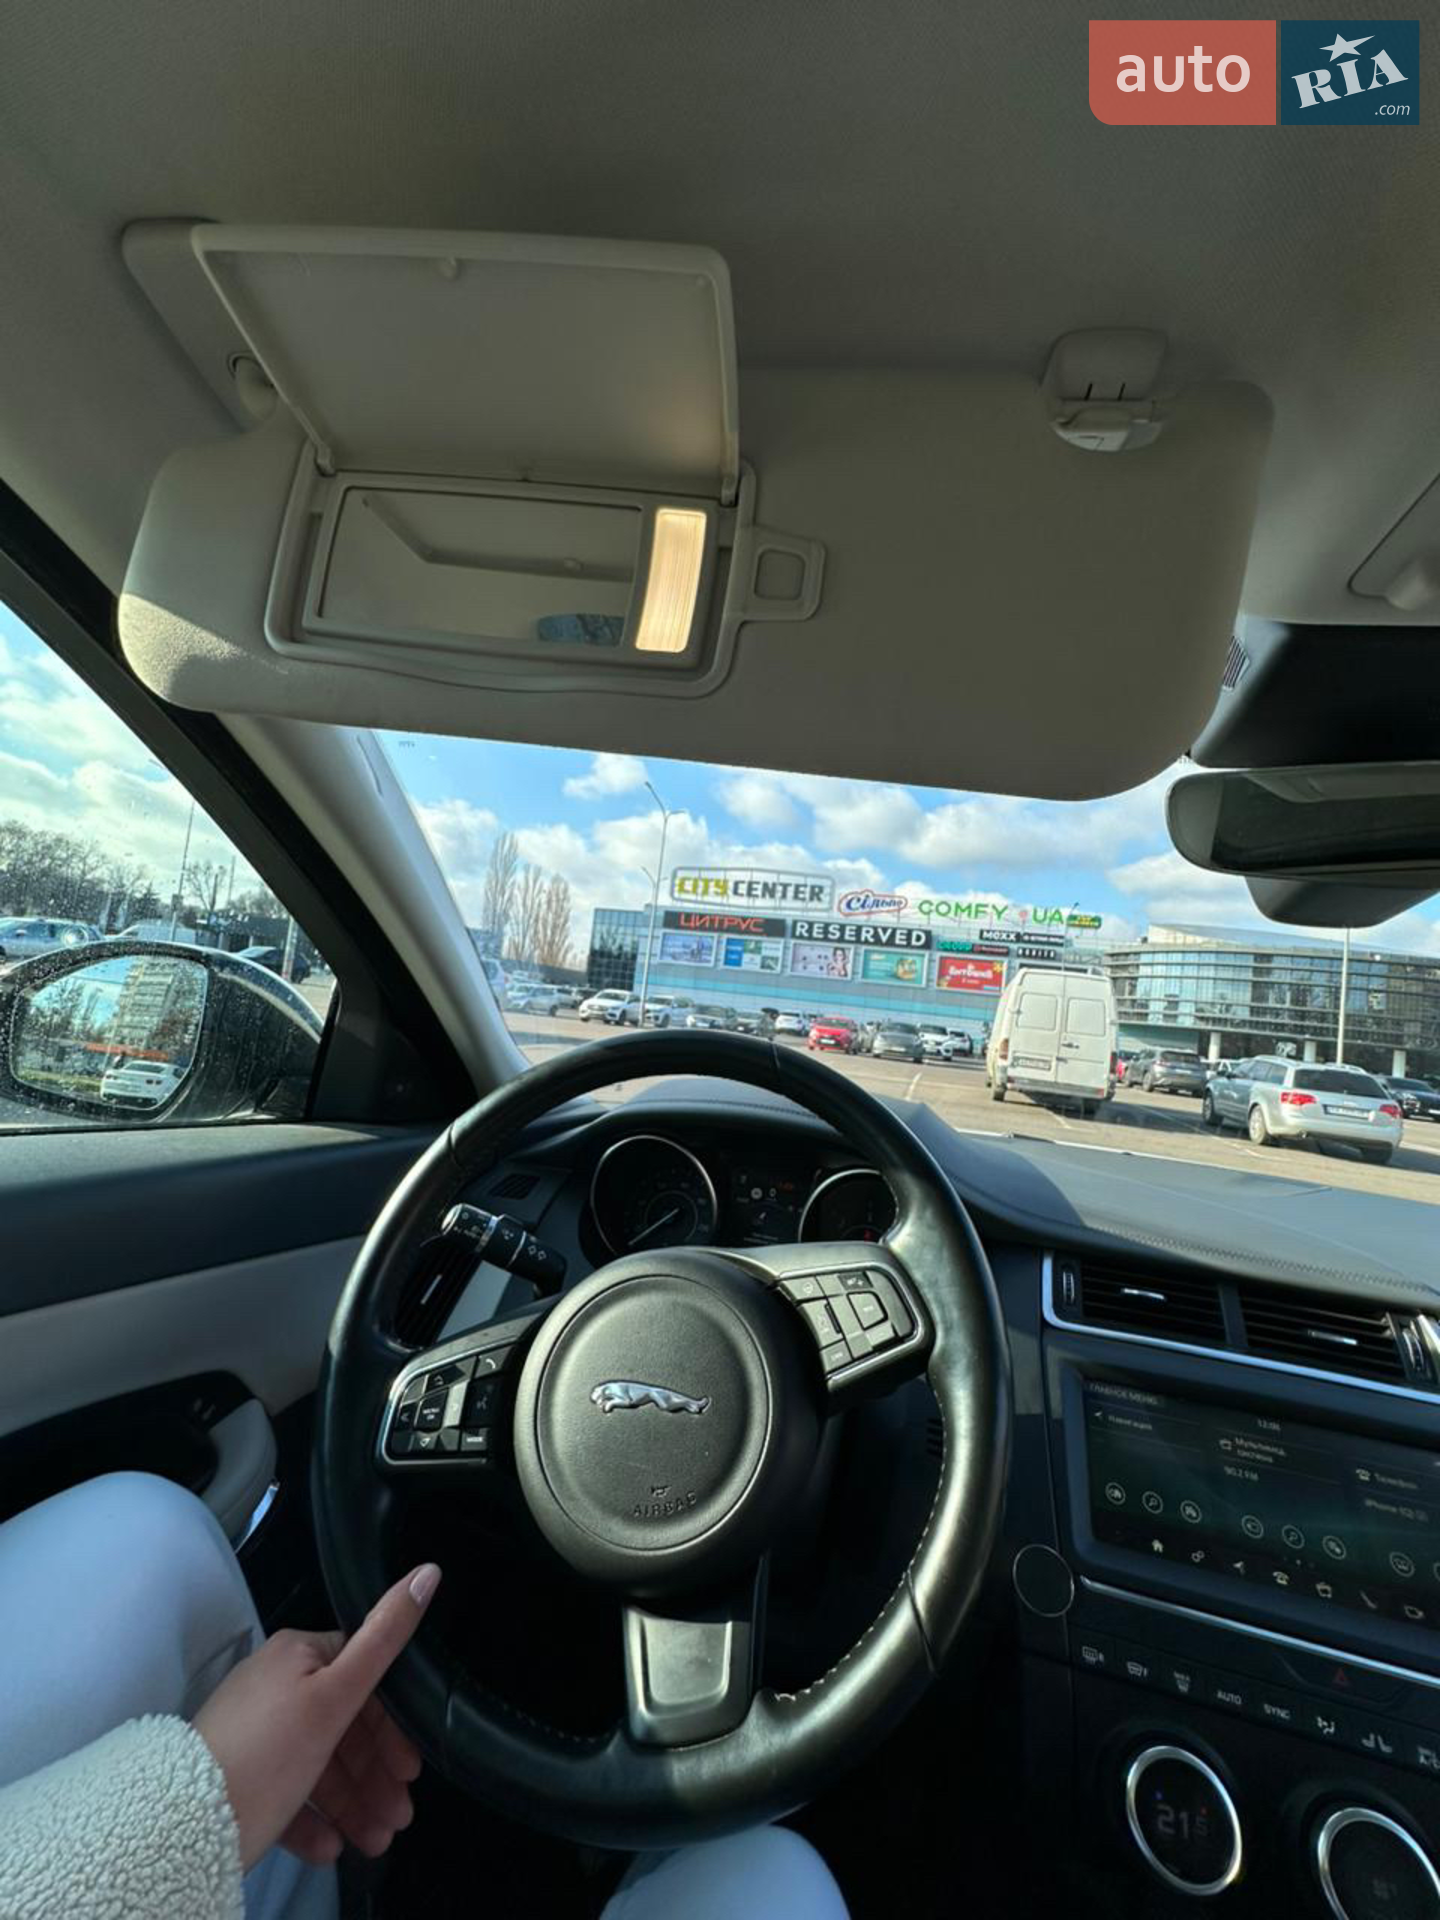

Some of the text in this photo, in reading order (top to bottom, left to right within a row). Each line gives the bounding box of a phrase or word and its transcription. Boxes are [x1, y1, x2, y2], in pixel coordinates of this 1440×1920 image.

[677, 876, 825, 902] CITY CENTER
[679, 913, 765, 932] ЦИТРУС
[918, 899, 1009, 920] COMFY
[1032, 907, 1065, 924] UA
[795, 922, 927, 946] RESERVED
